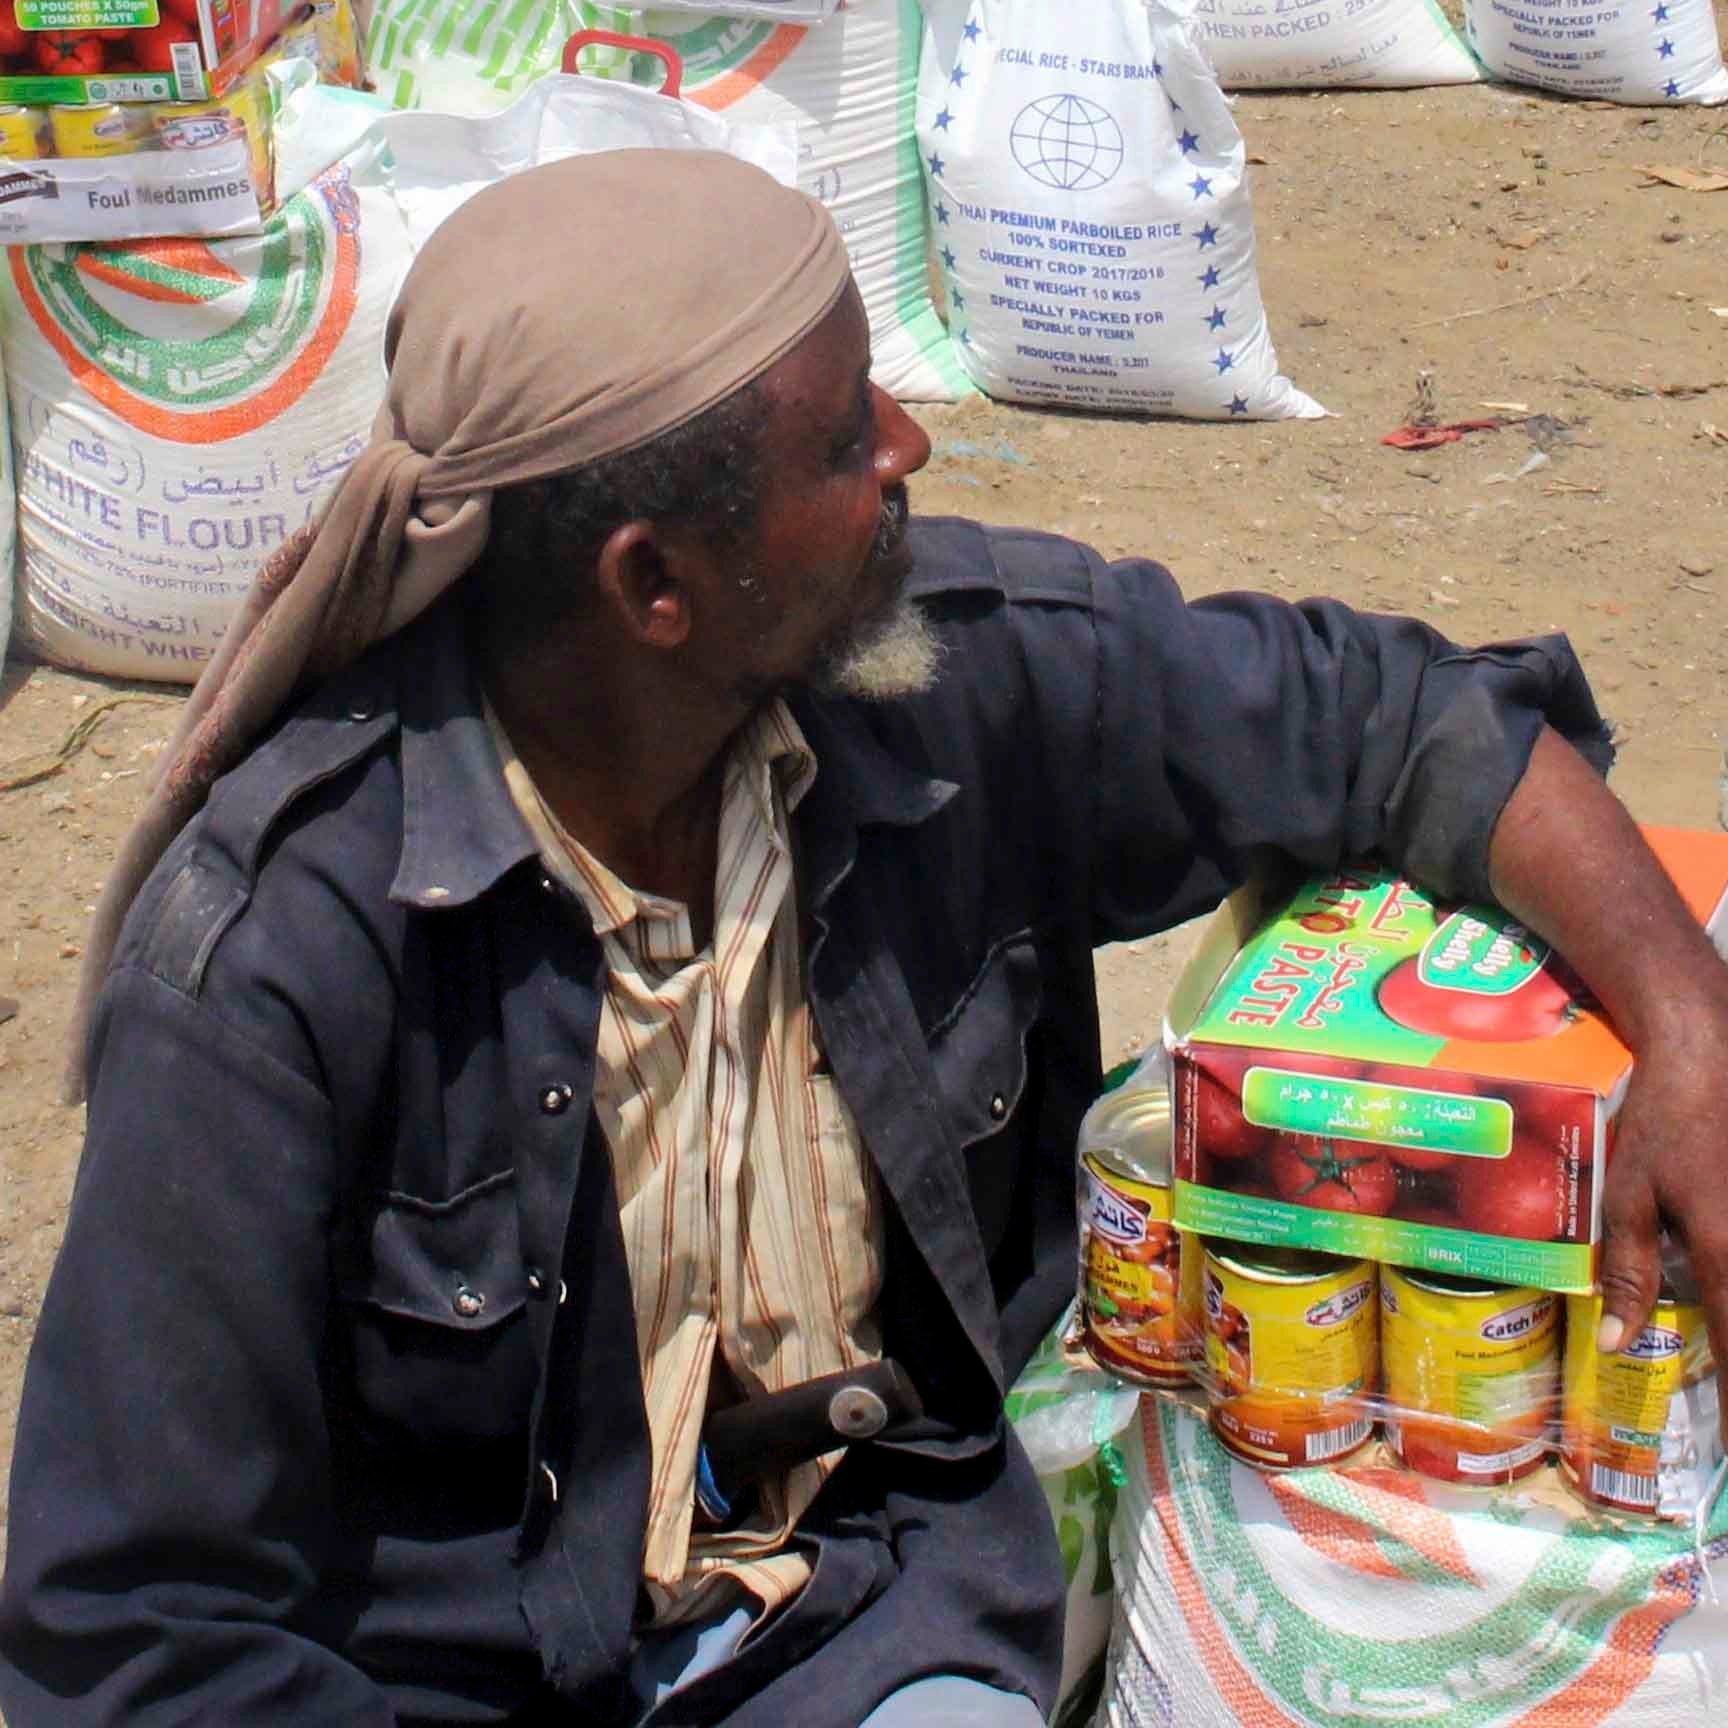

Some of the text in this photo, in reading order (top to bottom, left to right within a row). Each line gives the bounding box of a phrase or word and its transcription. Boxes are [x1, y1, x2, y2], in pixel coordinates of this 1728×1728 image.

[39, 0, 102, 13] POUCHES
[114, 0, 149, 15] 50gm
[39, 11, 135, 26] TOMATO PASTE
[1251, 11, 1331, 40] PACKED
[1039, 52, 1122, 78] RICE STARS
[88, 177, 251, 210] Foul Medammes
[959, 202, 1183, 241] THAI PREMIUM PARBOILED RICE
[1008, 231, 1127, 259] 100% SORTEXED
[978, 248, 1042, 271] CURRENT
[1047, 261, 1088, 276] CROP
[1004, 274, 1142, 303] NET WEIGHT 10 KGS
[989, 293, 1165, 326] SPECIALLY PACKED FOR
[136, 507, 287, 550] FLOUR
[1429, 915, 1490, 970] Shelly
[1228, 941, 1328, 1030] PASTE
[1482, 1312, 1530, 1339] Catch
